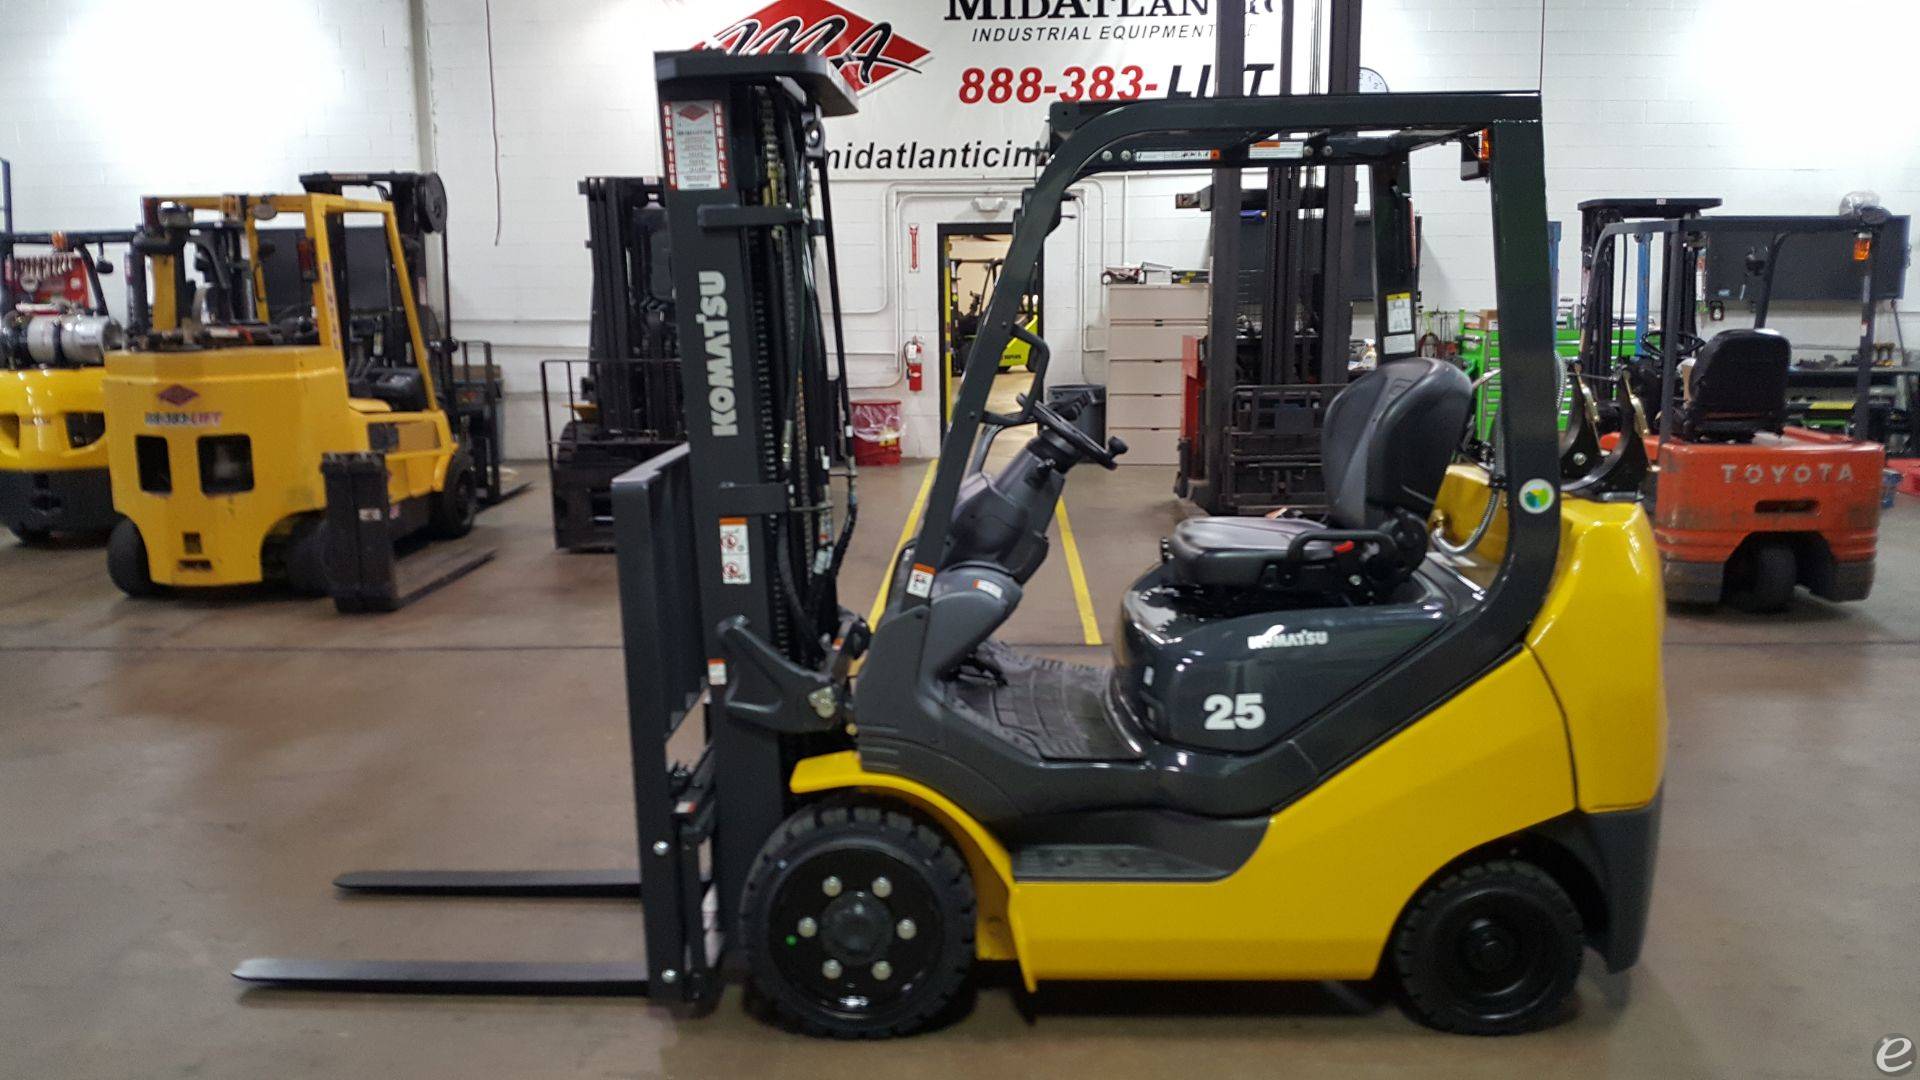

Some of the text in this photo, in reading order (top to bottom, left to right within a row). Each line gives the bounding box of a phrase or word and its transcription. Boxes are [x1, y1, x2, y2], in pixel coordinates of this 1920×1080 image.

[944, 0, 1273, 20] MIDATLANI
[972, 24, 1216, 42] INDUSTRIAL EQUIPMENT
[959, 64, 1274, 104] 888-383-LIT
[696, 270, 738, 437] KOMATSU
[1721, 463, 1855, 484] TOYOTA
[1203, 693, 1266, 730] 25
